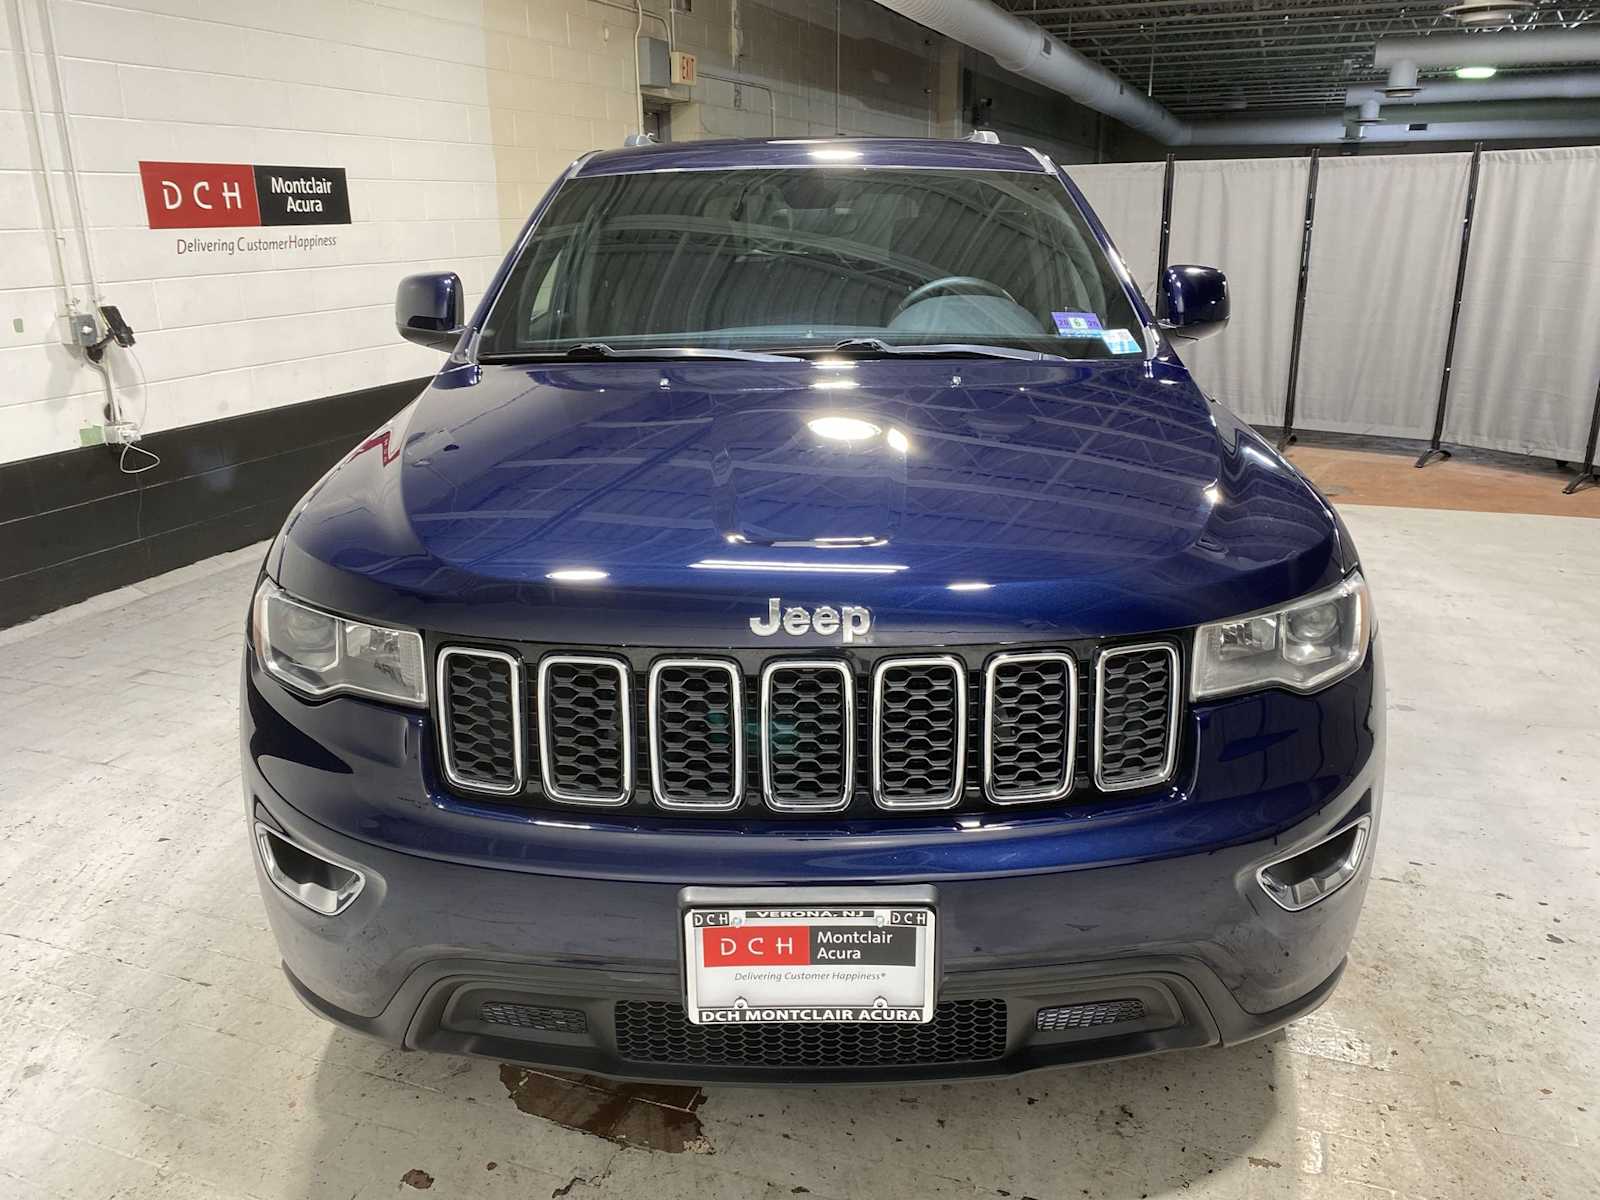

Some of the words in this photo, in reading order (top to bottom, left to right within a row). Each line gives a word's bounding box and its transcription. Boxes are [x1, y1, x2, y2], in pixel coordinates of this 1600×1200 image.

[271, 176, 332, 195] Montclair
[286, 196, 323, 213] Acura
[177, 239, 235, 255] Delivering
[749, 597, 871, 643] Jeep
[695, 914, 729, 926] DCH
[892, 912, 926, 924] DCH
[816, 931, 893, 944] Montclair
[720, 937, 793, 956] DCH
[816, 947, 861, 960] Acura
[734, 971, 782, 981] Delivering
[784, 971, 830, 980] Customer
[702, 1011, 740, 1021] DCH
[745, 1009, 853, 1021] MONTCLAIR
[858, 1009, 921, 1021] ACURA
